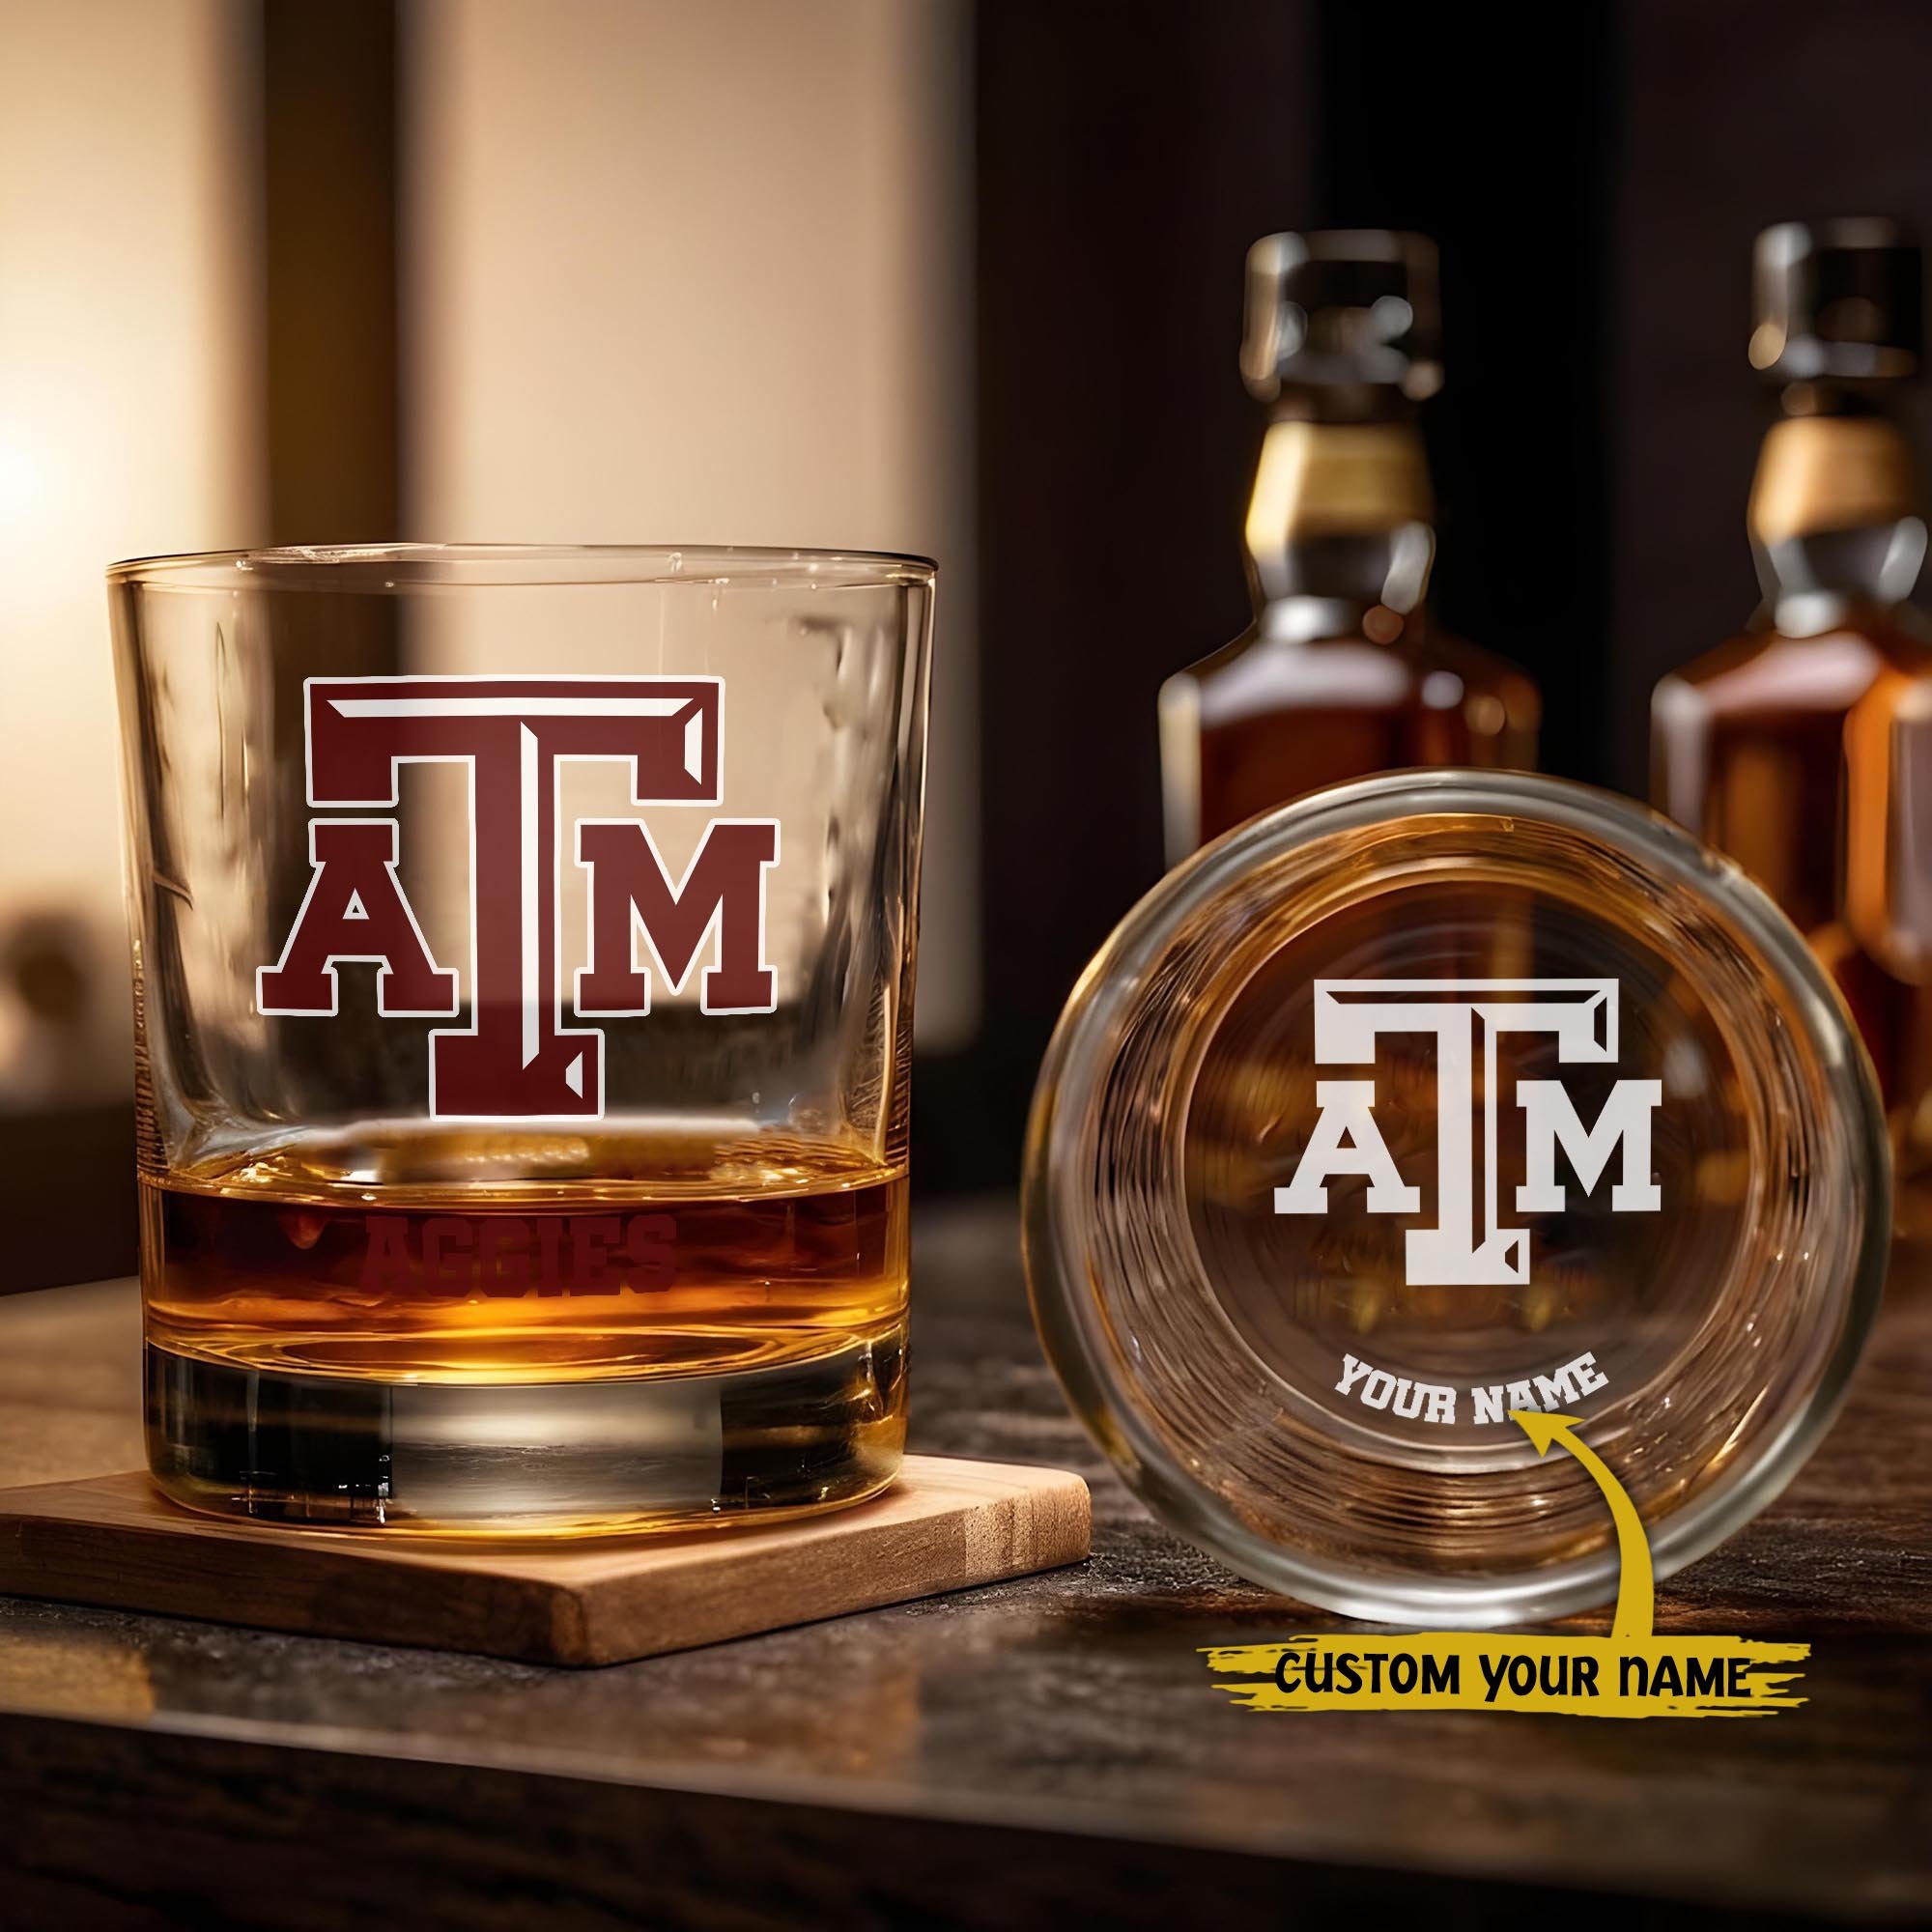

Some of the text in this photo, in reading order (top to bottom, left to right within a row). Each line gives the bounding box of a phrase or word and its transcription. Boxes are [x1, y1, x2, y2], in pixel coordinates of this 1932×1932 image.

[359, 1213, 678, 1298] AGGIES
[1334, 1350, 1610, 1425] YOUR NAME
